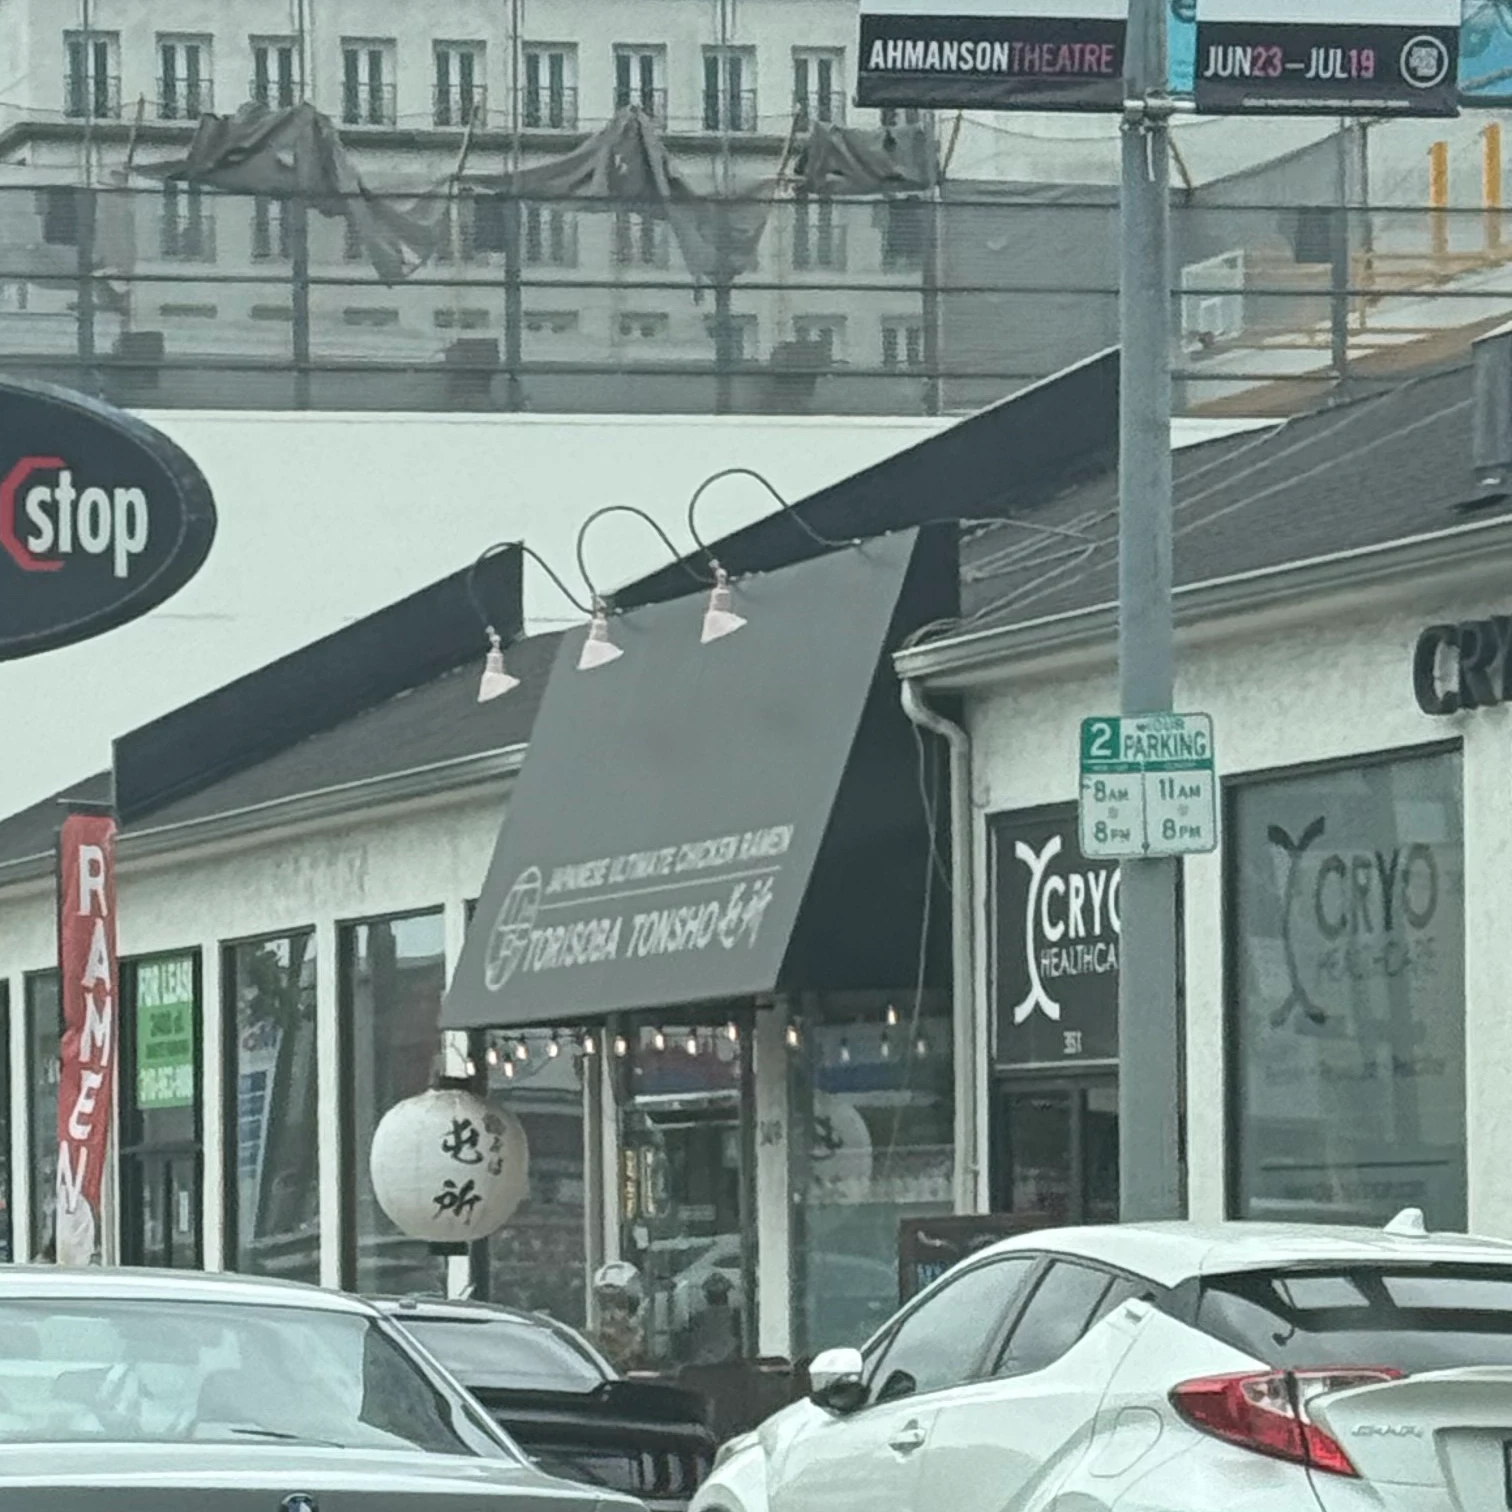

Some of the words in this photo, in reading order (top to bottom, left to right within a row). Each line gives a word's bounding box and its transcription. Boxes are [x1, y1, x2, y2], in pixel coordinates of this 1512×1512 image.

[868, 39, 1009, 71] AHMANSON
[1011, 42, 1115, 73] THEATRE
[24, 469, 148, 578] stop
[1090, 722, 1112, 757] 2
[1124, 731, 1206, 760] PARKING
[1315, 842, 1438, 940] CRYO
[523, 916, 623, 973] TORISOBA
[627, 900, 720, 958] TONSHO
[57, 844, 112, 1214] RAMEN
